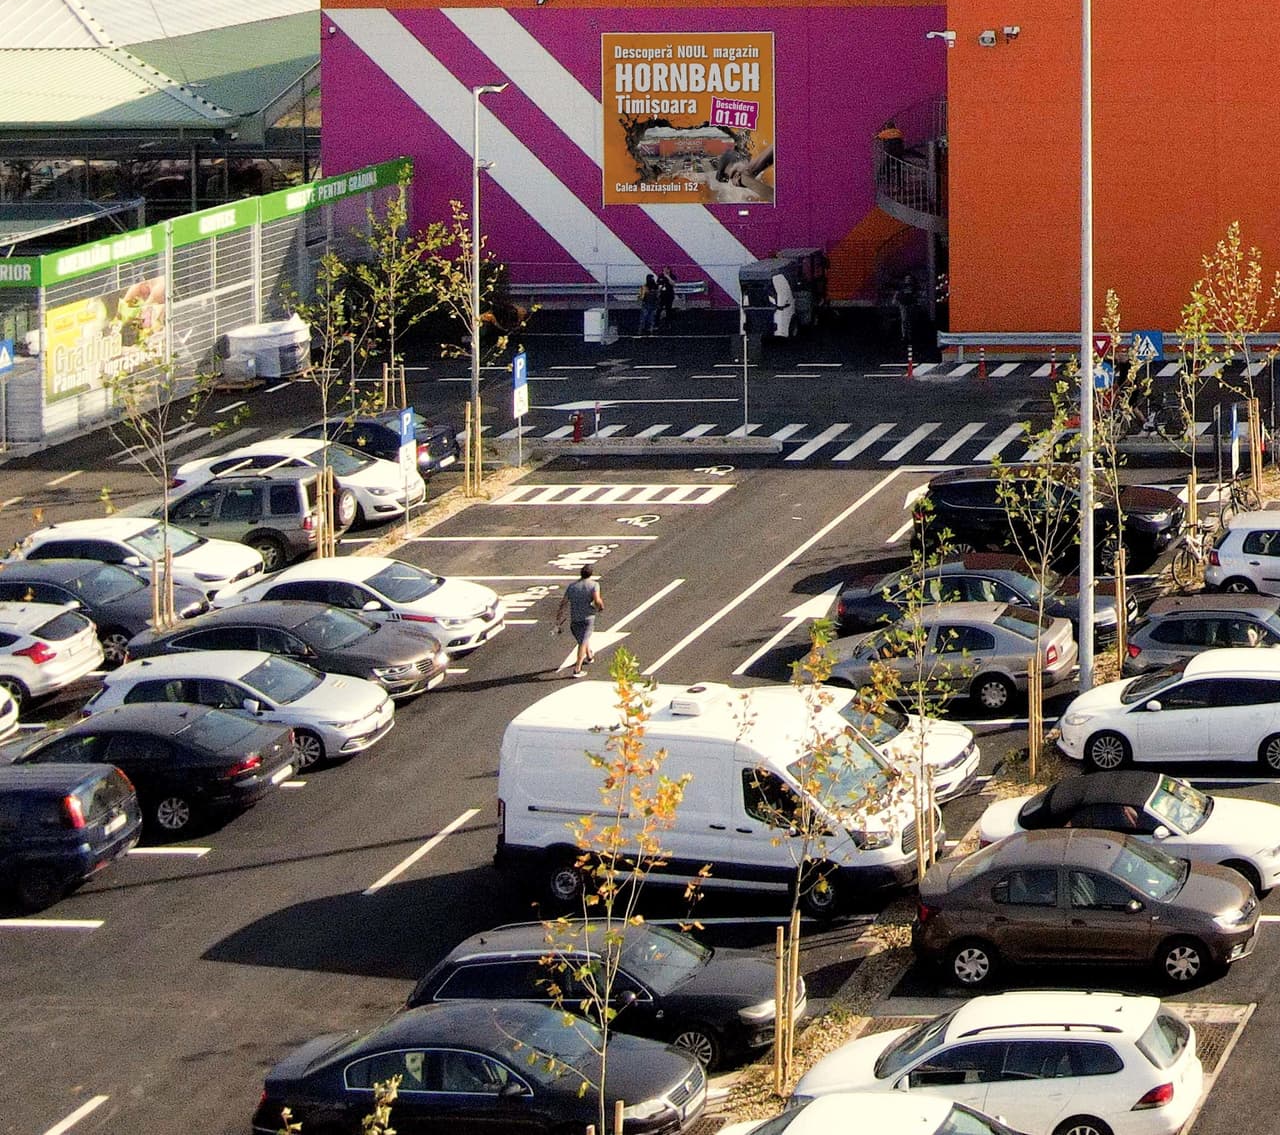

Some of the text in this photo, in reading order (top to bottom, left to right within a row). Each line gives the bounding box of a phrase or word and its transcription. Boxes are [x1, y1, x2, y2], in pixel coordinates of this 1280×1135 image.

[614, 44, 759, 62] Descoperă NOUL magazin
[615, 62, 760, 93] HORNBACH
[615, 94, 697, 120] Timișoara
[715, 100, 755, 113] Deschidere
[715, 110, 752, 127] 01.10.
[615, 182, 699, 194] Calea Buziașului 152
[516, 358, 524, 378] P
[403, 412, 411, 435] P
